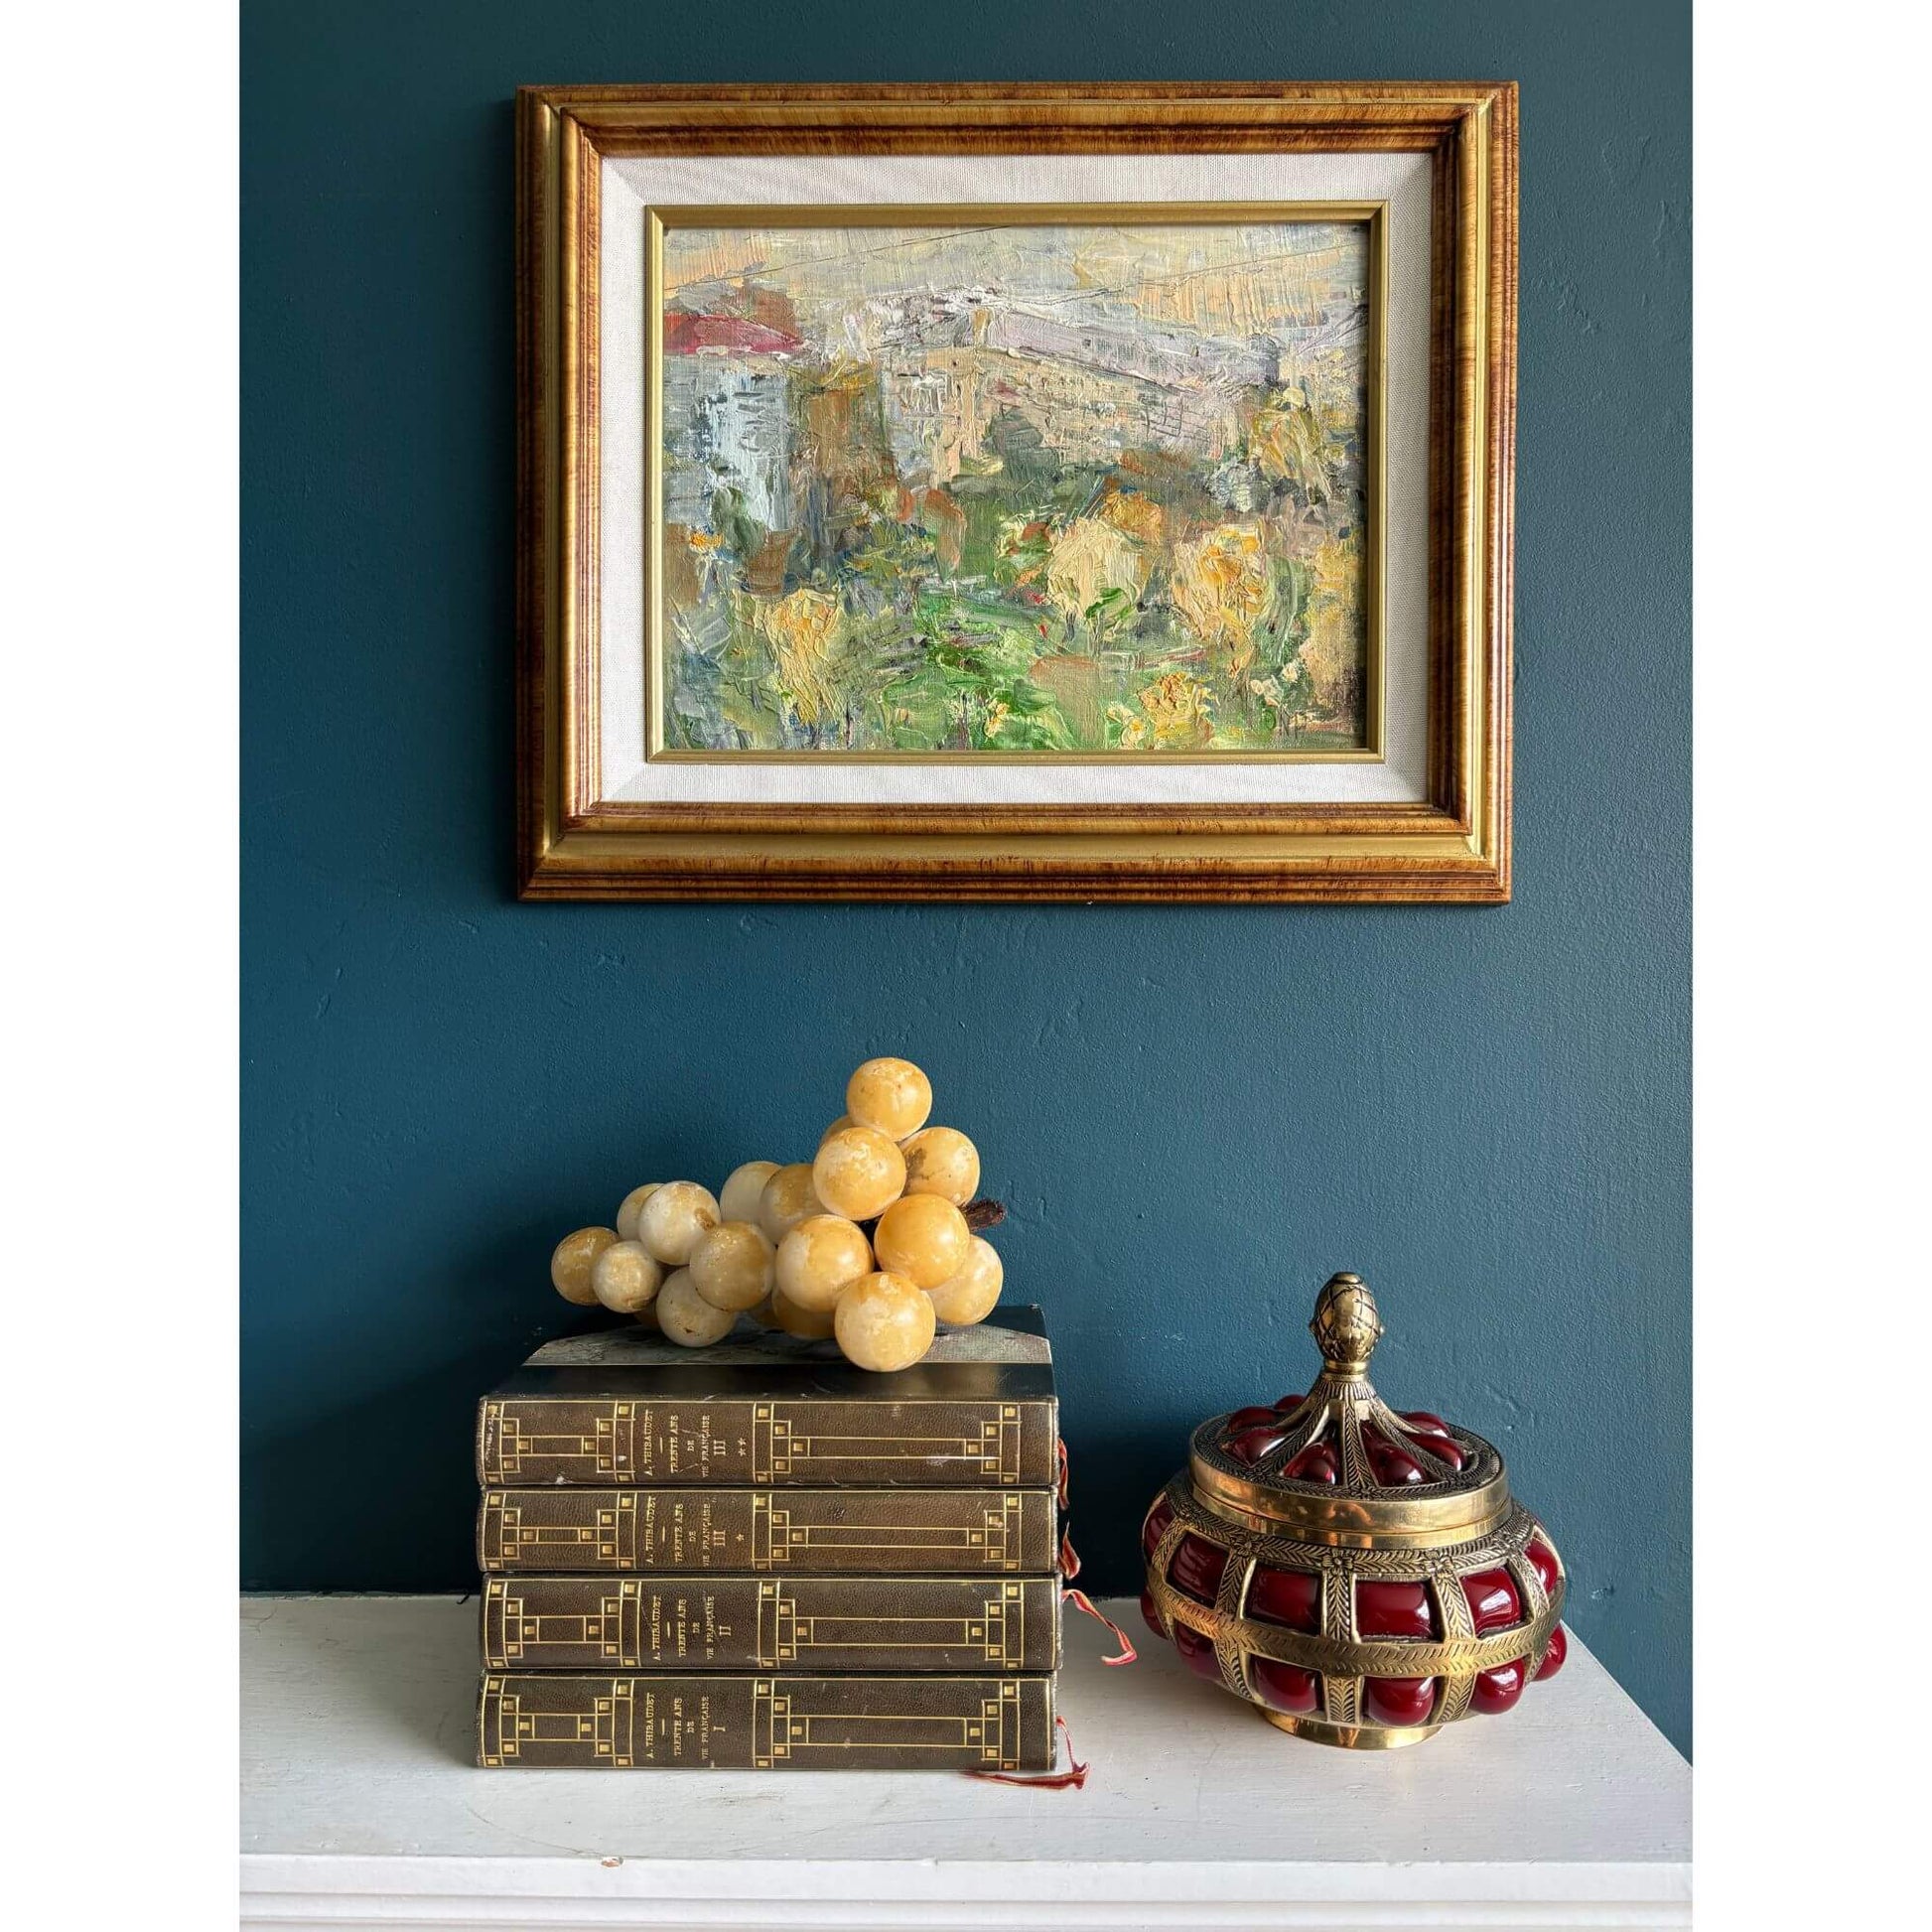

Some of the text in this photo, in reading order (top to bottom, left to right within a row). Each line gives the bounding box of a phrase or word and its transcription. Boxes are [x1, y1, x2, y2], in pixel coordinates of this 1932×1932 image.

[644, 1409, 654, 1464] THIBAUDET
[687, 1440, 695, 1451] DE
[713, 1439, 727, 1456] III
[645, 1495, 656, 1551] THIBAUDET
[674, 1503, 684, 1563] TRENTE ANS
[688, 1530, 696, 1542] DE
[713, 1529, 726, 1547] III
[651, 1594, 662, 1649] THIBAUDET
[677, 1598, 687, 1658] TRENTE ANS
[692, 1621, 700, 1634] DE
[719, 1625, 732, 1636] II
[645, 1692, 655, 1747] THIBAUDET
[686, 1721, 694, 1733] DE
[673, 1720, 682, 1756] TRENTE
